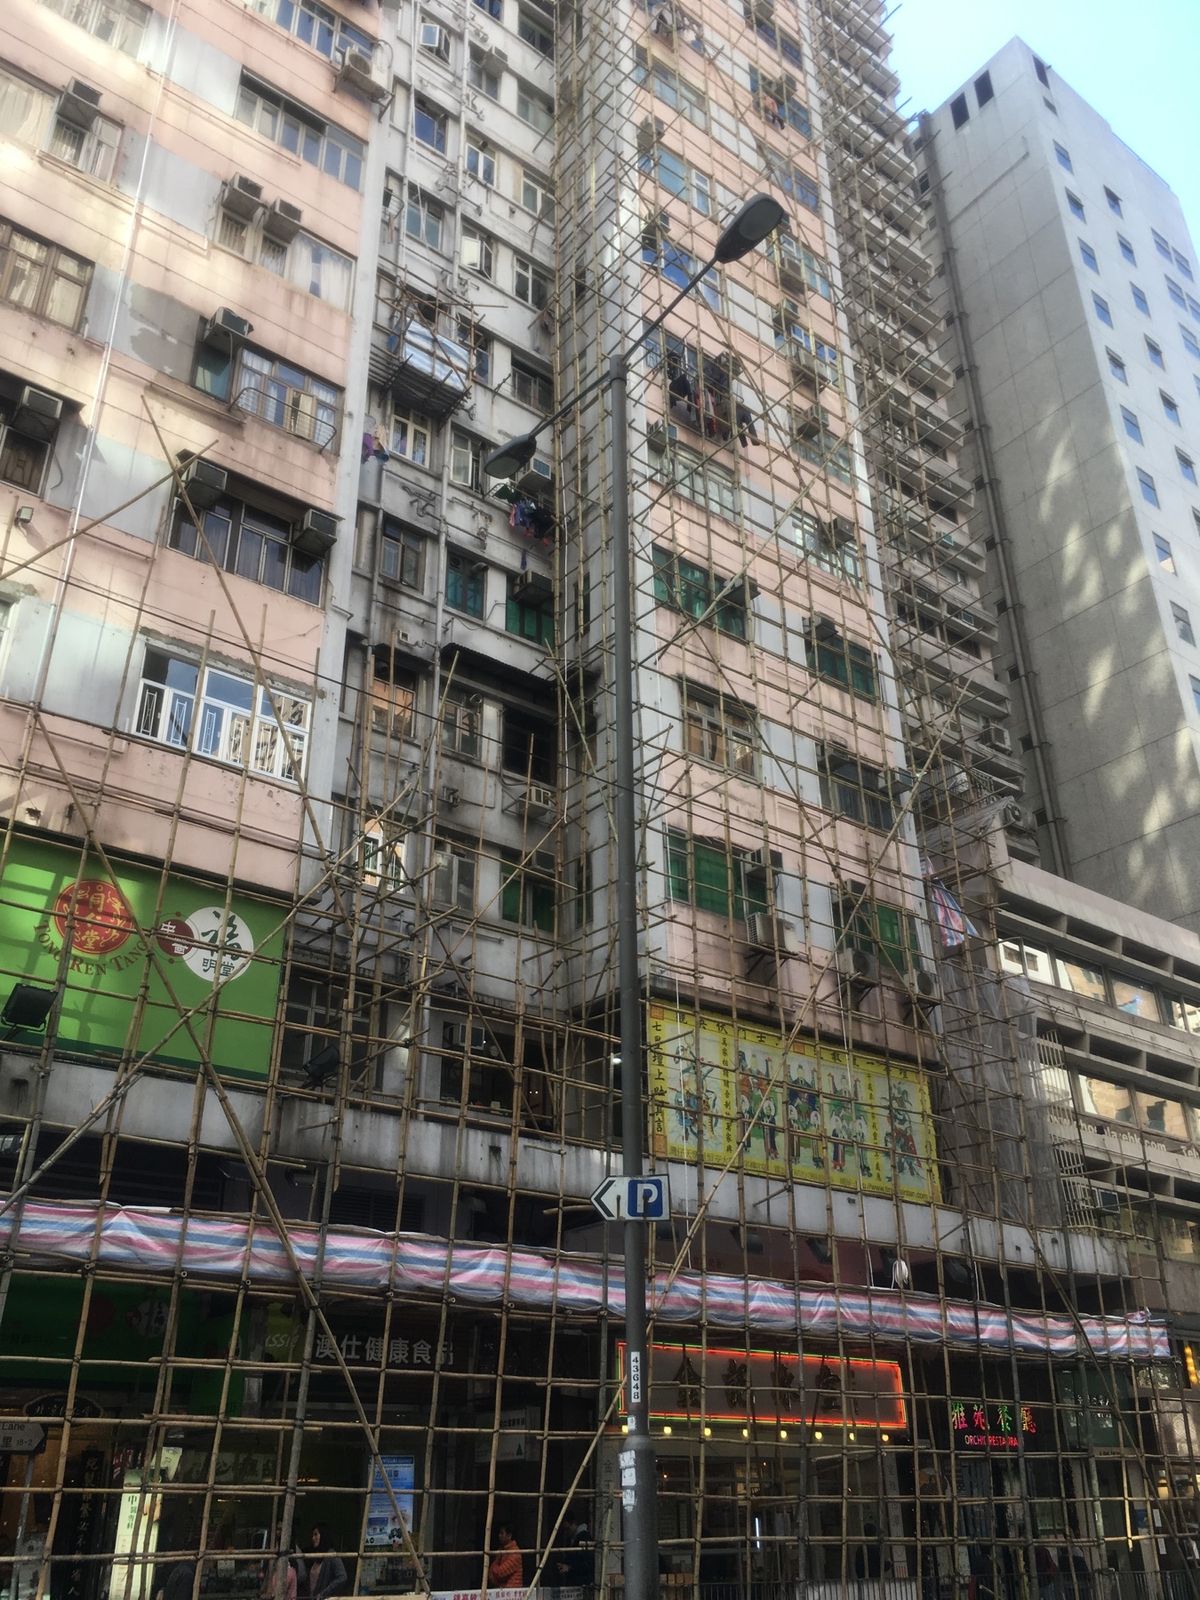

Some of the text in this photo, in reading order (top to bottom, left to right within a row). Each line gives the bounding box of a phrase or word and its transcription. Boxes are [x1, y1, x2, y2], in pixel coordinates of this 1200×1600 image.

[70, 957, 108, 976] REN
[111, 940, 149, 972] TANG
[636, 1182, 658, 1213] P
[631, 1355, 640, 1400] 43648
